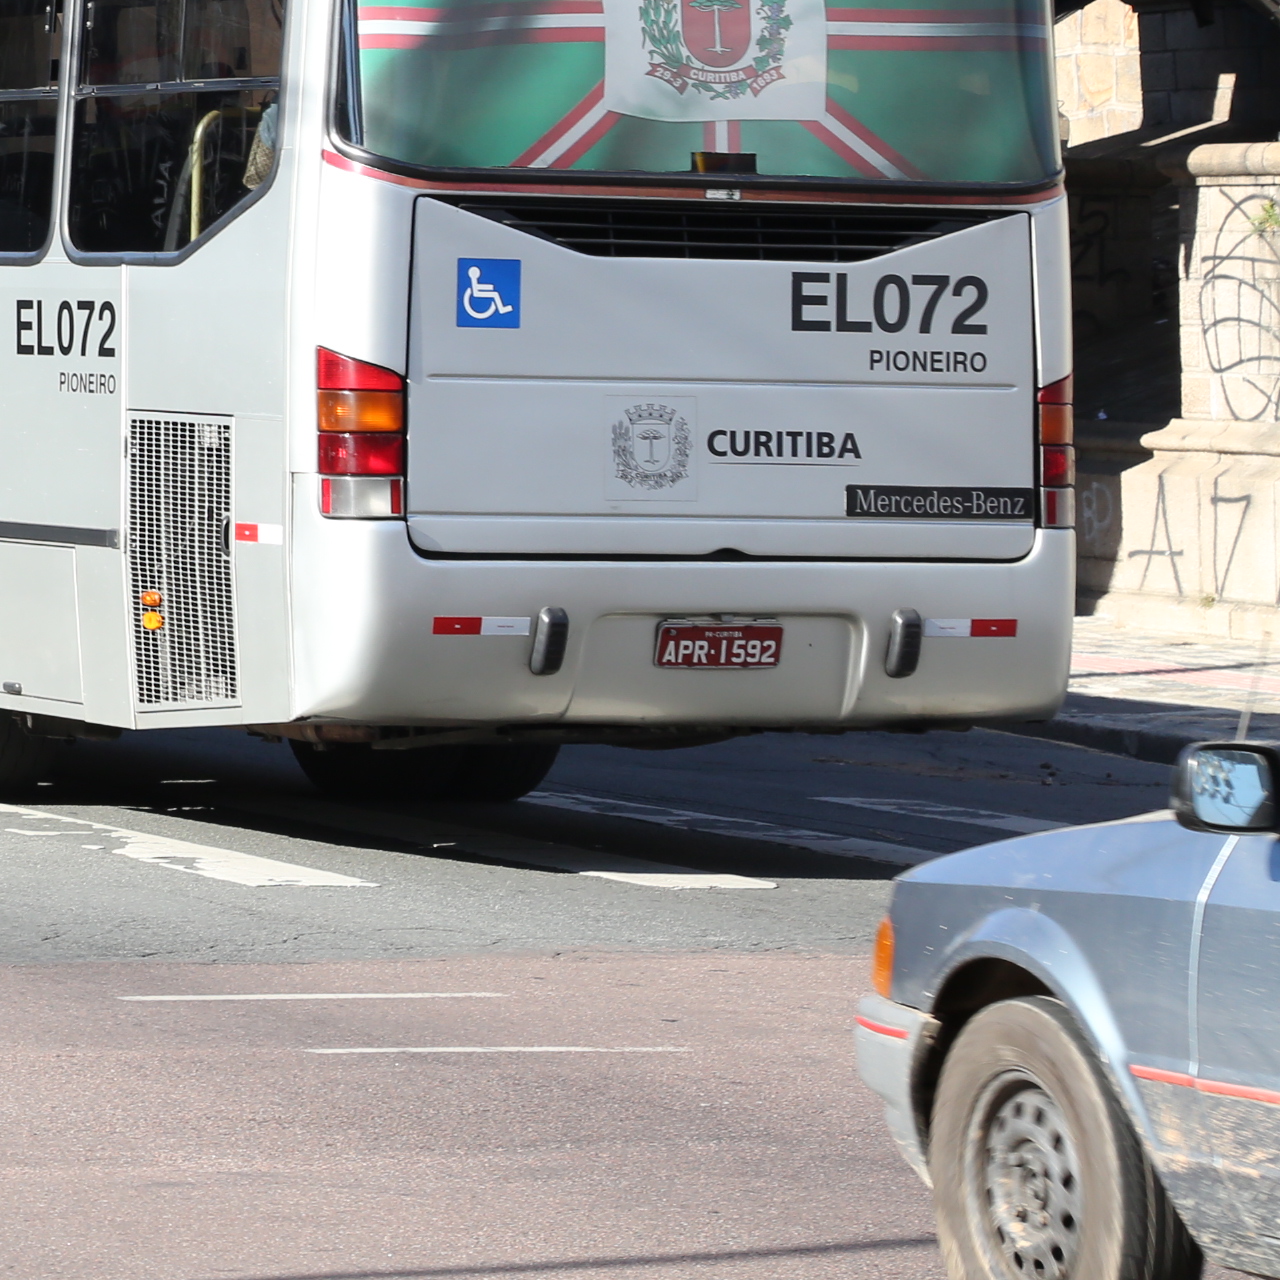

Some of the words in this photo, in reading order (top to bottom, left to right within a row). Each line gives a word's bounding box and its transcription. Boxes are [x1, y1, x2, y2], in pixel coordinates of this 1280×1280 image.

[689, 68, 746, 82] CURITIBA
[751, 70, 780, 91] 1693
[791, 271, 988, 335] EL072
[16, 300, 116, 358] EL072
[869, 350, 988, 373] PIONEIRO
[59, 372, 117, 395] PIONEIRO
[706, 429, 862, 460] CURITIBA
[856, 488, 1026, 516] Mercedes-Benz
